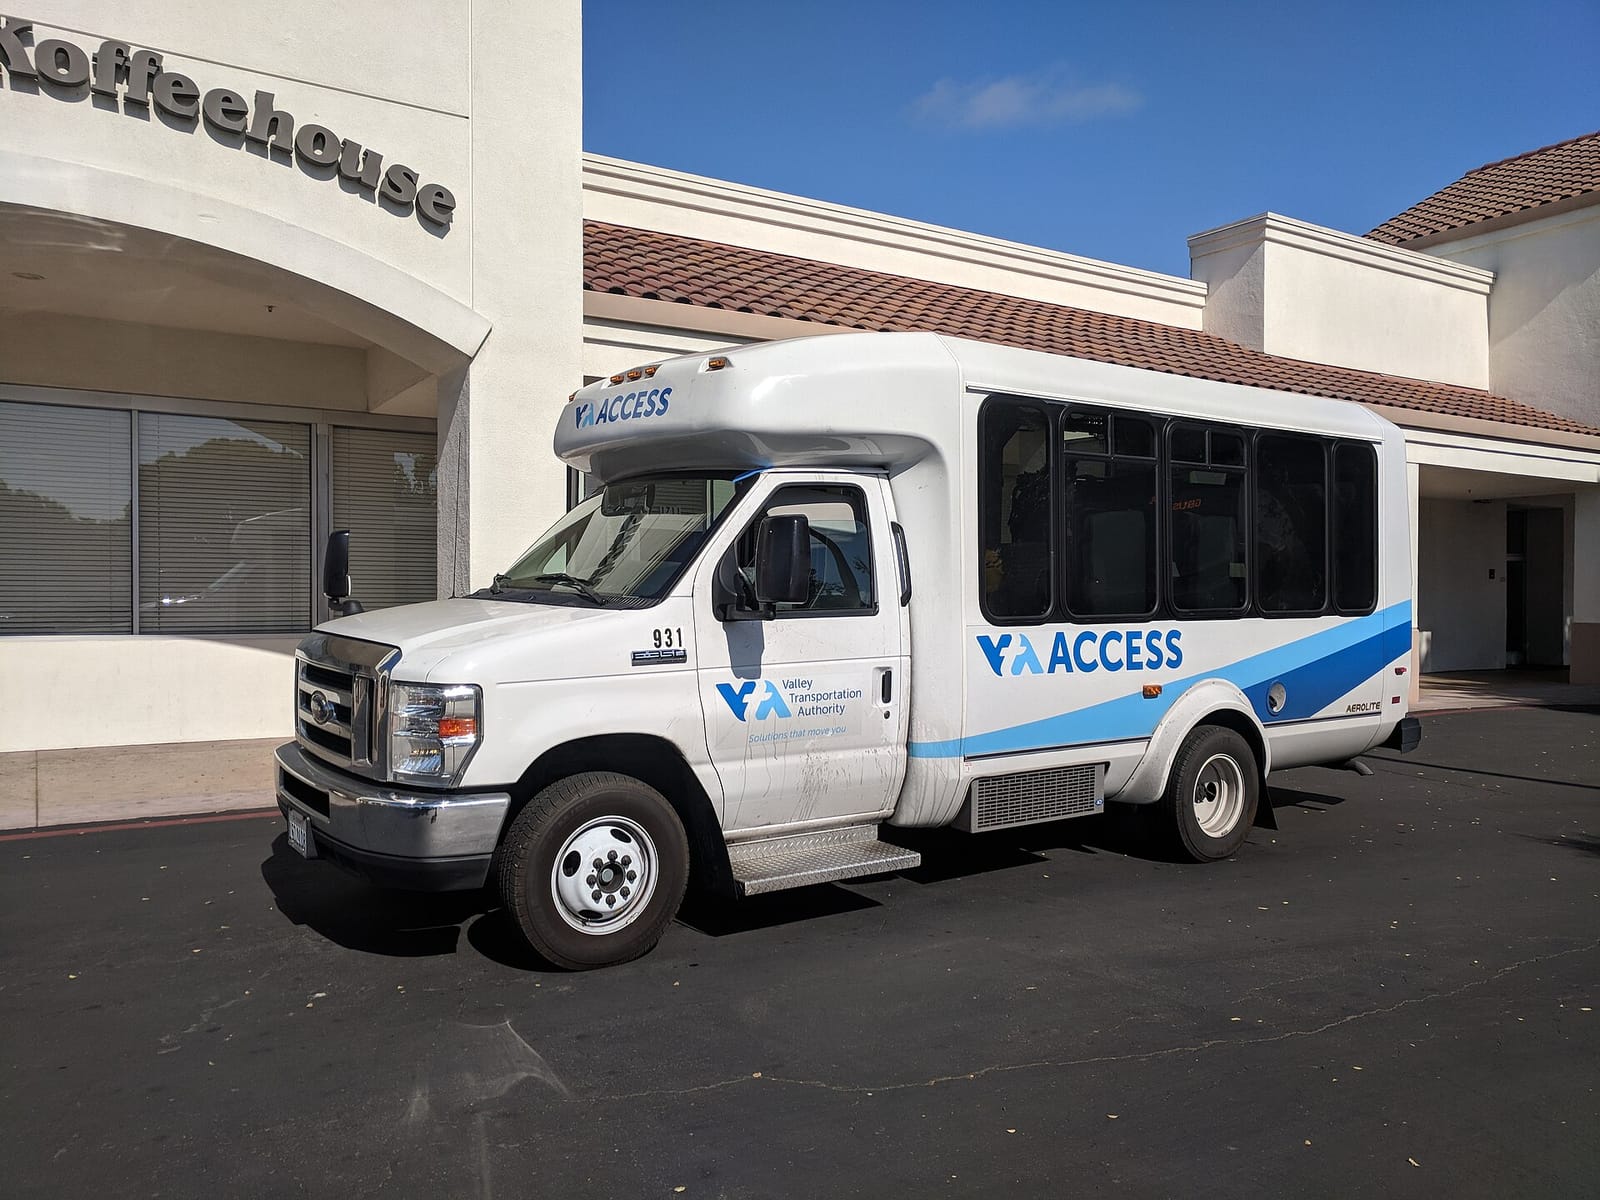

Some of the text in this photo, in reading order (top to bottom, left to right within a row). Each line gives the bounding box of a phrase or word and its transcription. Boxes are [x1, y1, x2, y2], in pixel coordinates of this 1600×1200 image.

[596, 387, 673, 425] ACCESS
[653, 627, 682, 648] 931
[1047, 629, 1183, 673] ACCESS
[782, 679, 813, 690] Valley
[789, 688, 862, 703] Transportation
[797, 704, 846, 717] Authority
[1346, 701, 1381, 713] AEROLITE
[749, 726, 847, 743] Solutions that move you
